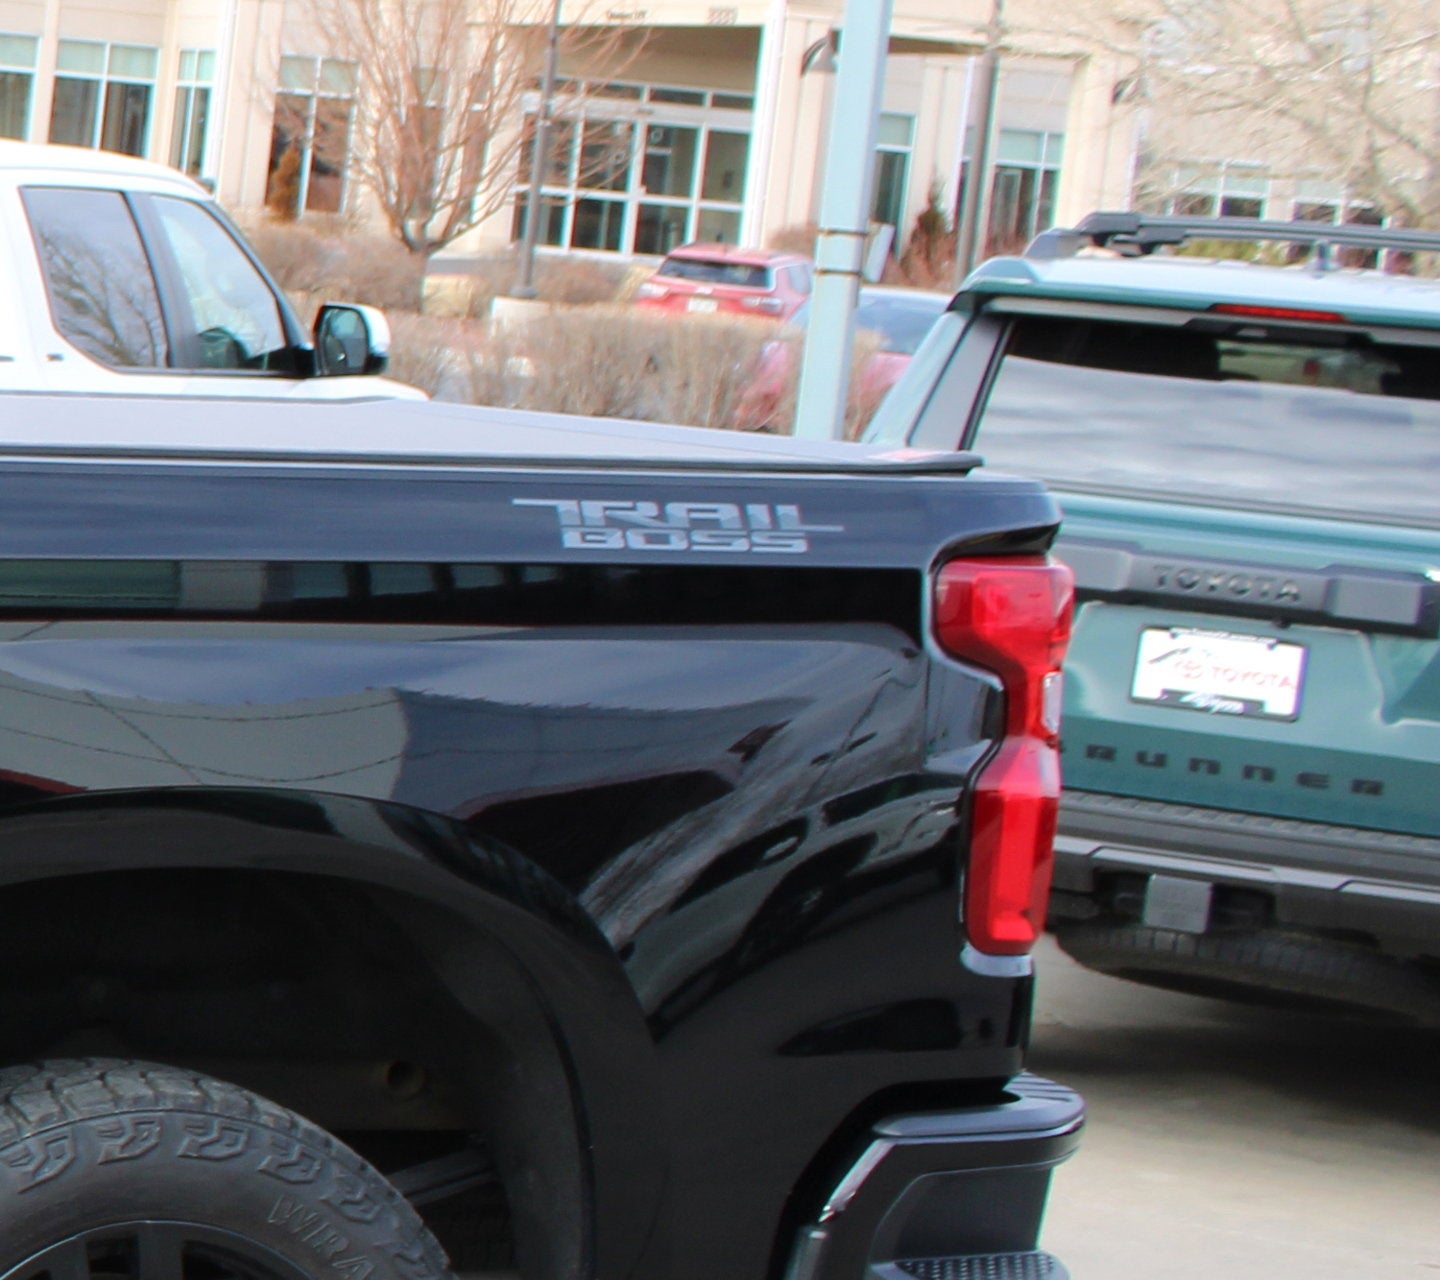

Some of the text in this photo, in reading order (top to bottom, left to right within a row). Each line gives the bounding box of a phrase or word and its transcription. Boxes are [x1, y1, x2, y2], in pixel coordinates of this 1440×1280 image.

[511, 497, 845, 533] TRAIL
[561, 526, 810, 554] BOSS
[1152, 564, 1302, 602] TOYOTA
[1211, 664, 1296, 689] TOYOTA
[1058, 734, 1386, 798] RUNNER
